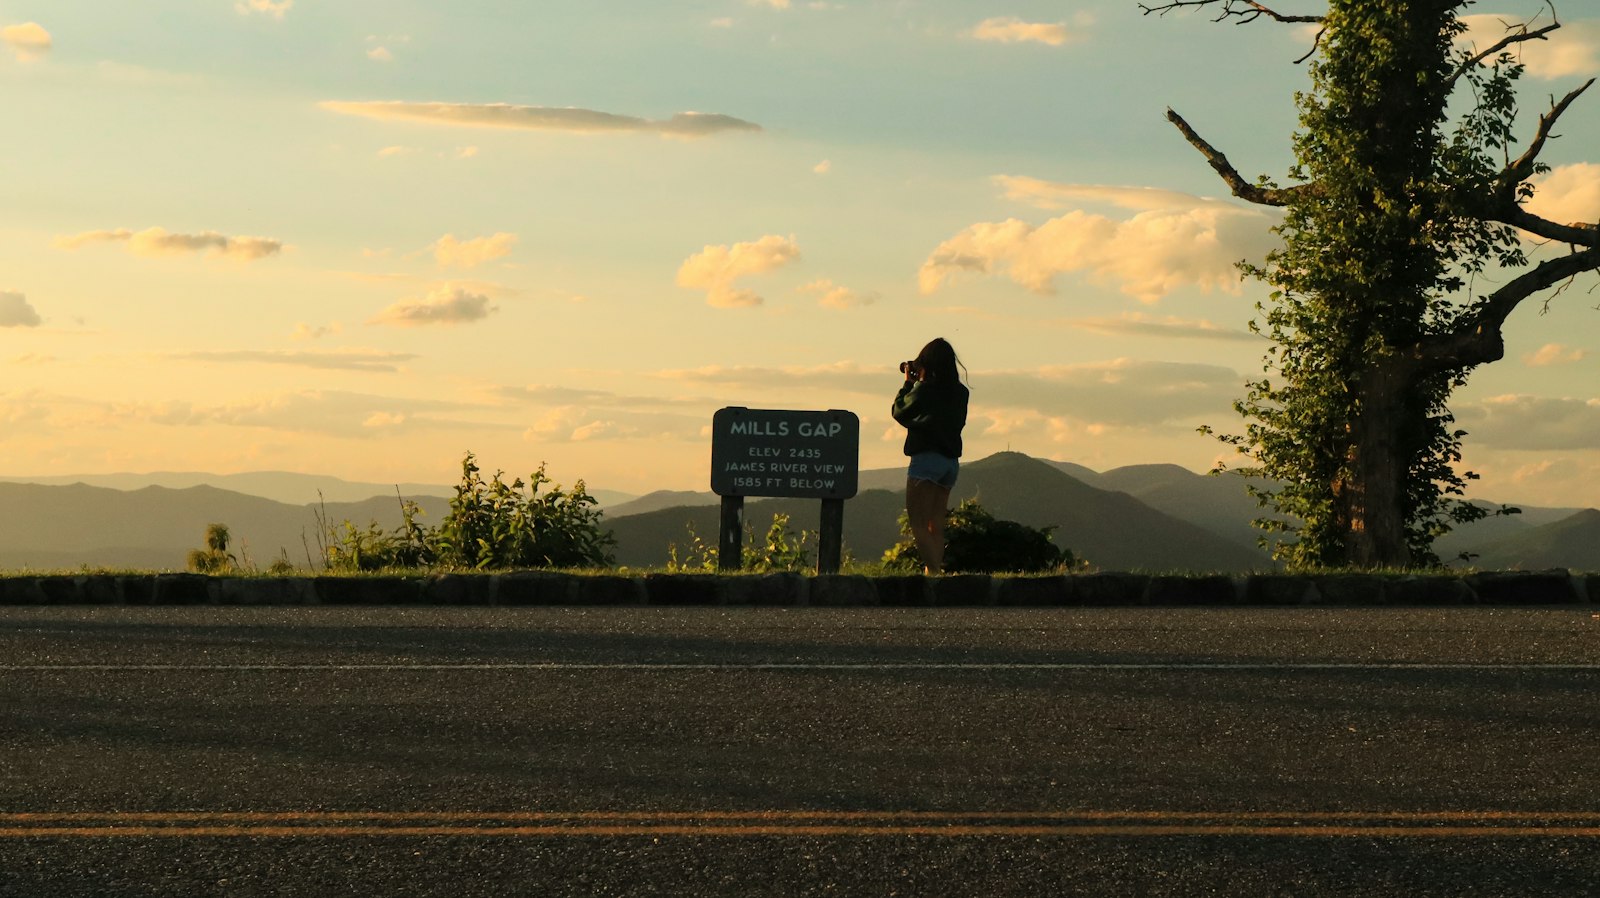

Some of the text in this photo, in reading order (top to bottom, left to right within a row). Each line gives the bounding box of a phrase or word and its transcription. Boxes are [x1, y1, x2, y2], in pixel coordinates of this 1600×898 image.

[730, 421, 842, 437] MILLS GAP
[748, 447, 821, 458] ELEV 2435
[725, 462, 845, 474] JAMES RIVER VIEW
[733, 477, 835, 489] 1585 FT BELOW
